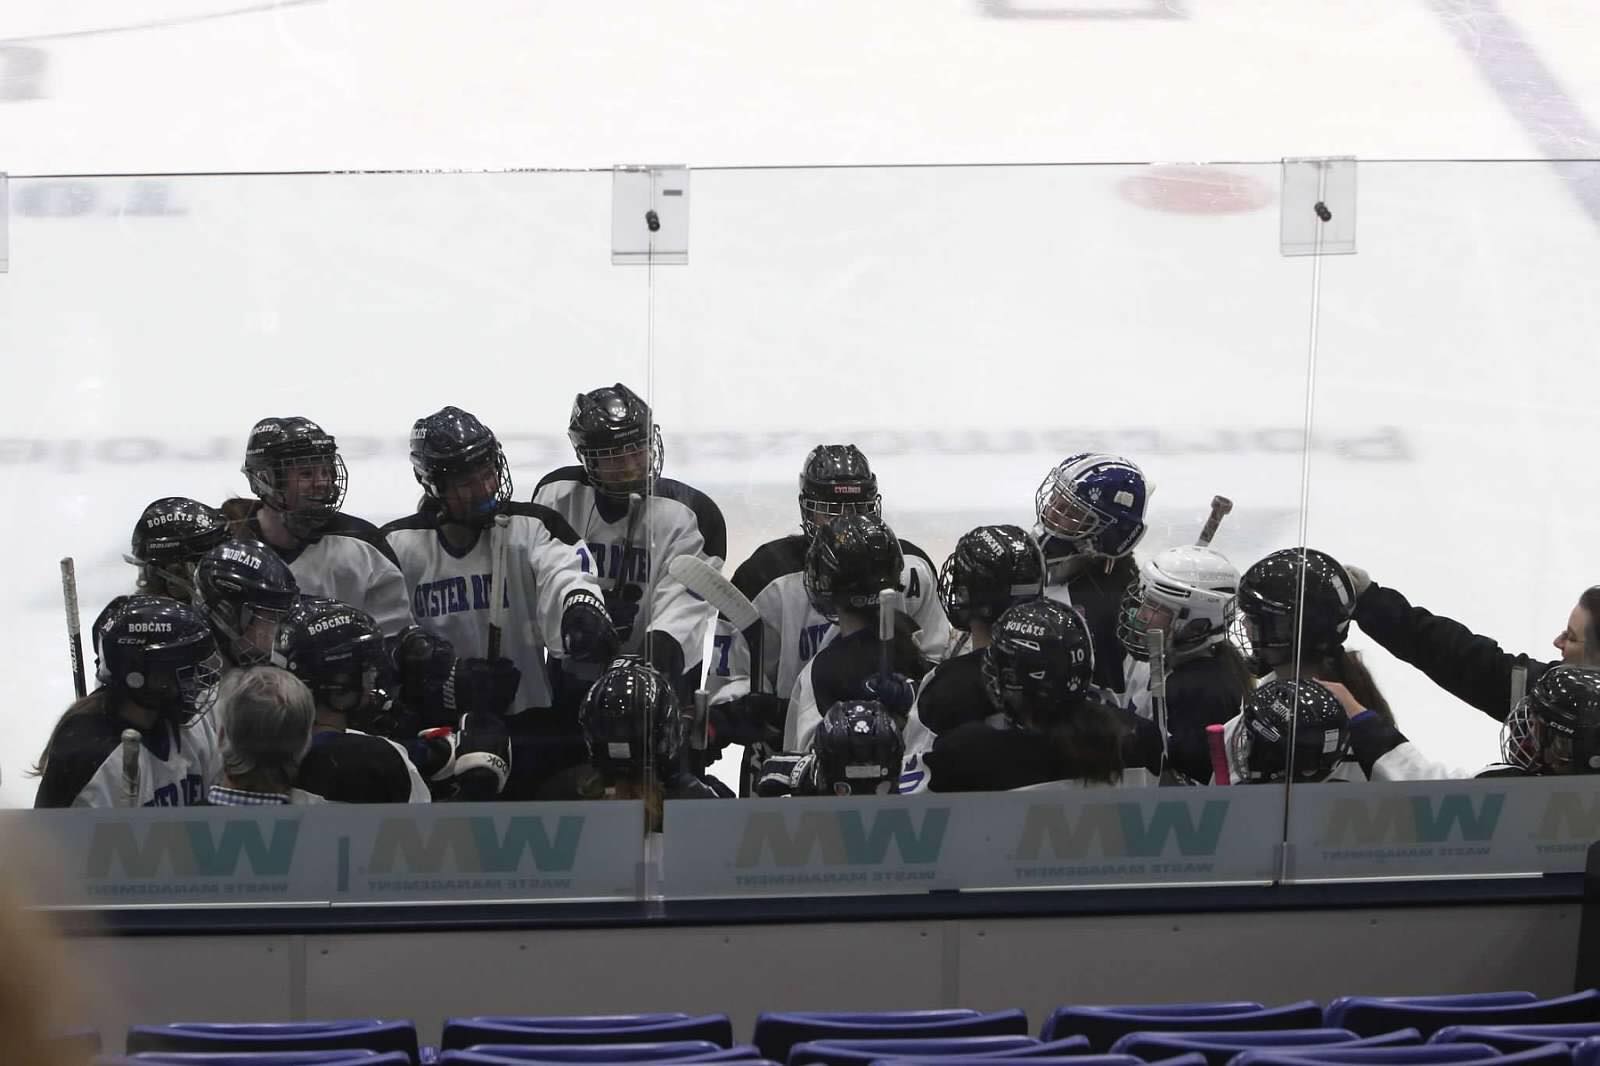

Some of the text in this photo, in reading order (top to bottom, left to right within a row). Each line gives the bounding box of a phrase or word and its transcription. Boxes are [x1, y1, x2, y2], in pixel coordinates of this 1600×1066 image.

[147, 512, 194, 528] BOBCATS
[221, 547, 263, 570] BOBCATS
[906, 567, 921, 598] A
[415, 576, 470, 617] OYSTER
[128, 622, 172, 633] BOBCATS
[307, 616, 350, 636] BOBCATS
[1004, 620, 1046, 637] BOBCATS
[1070, 648, 1085, 663] 10
